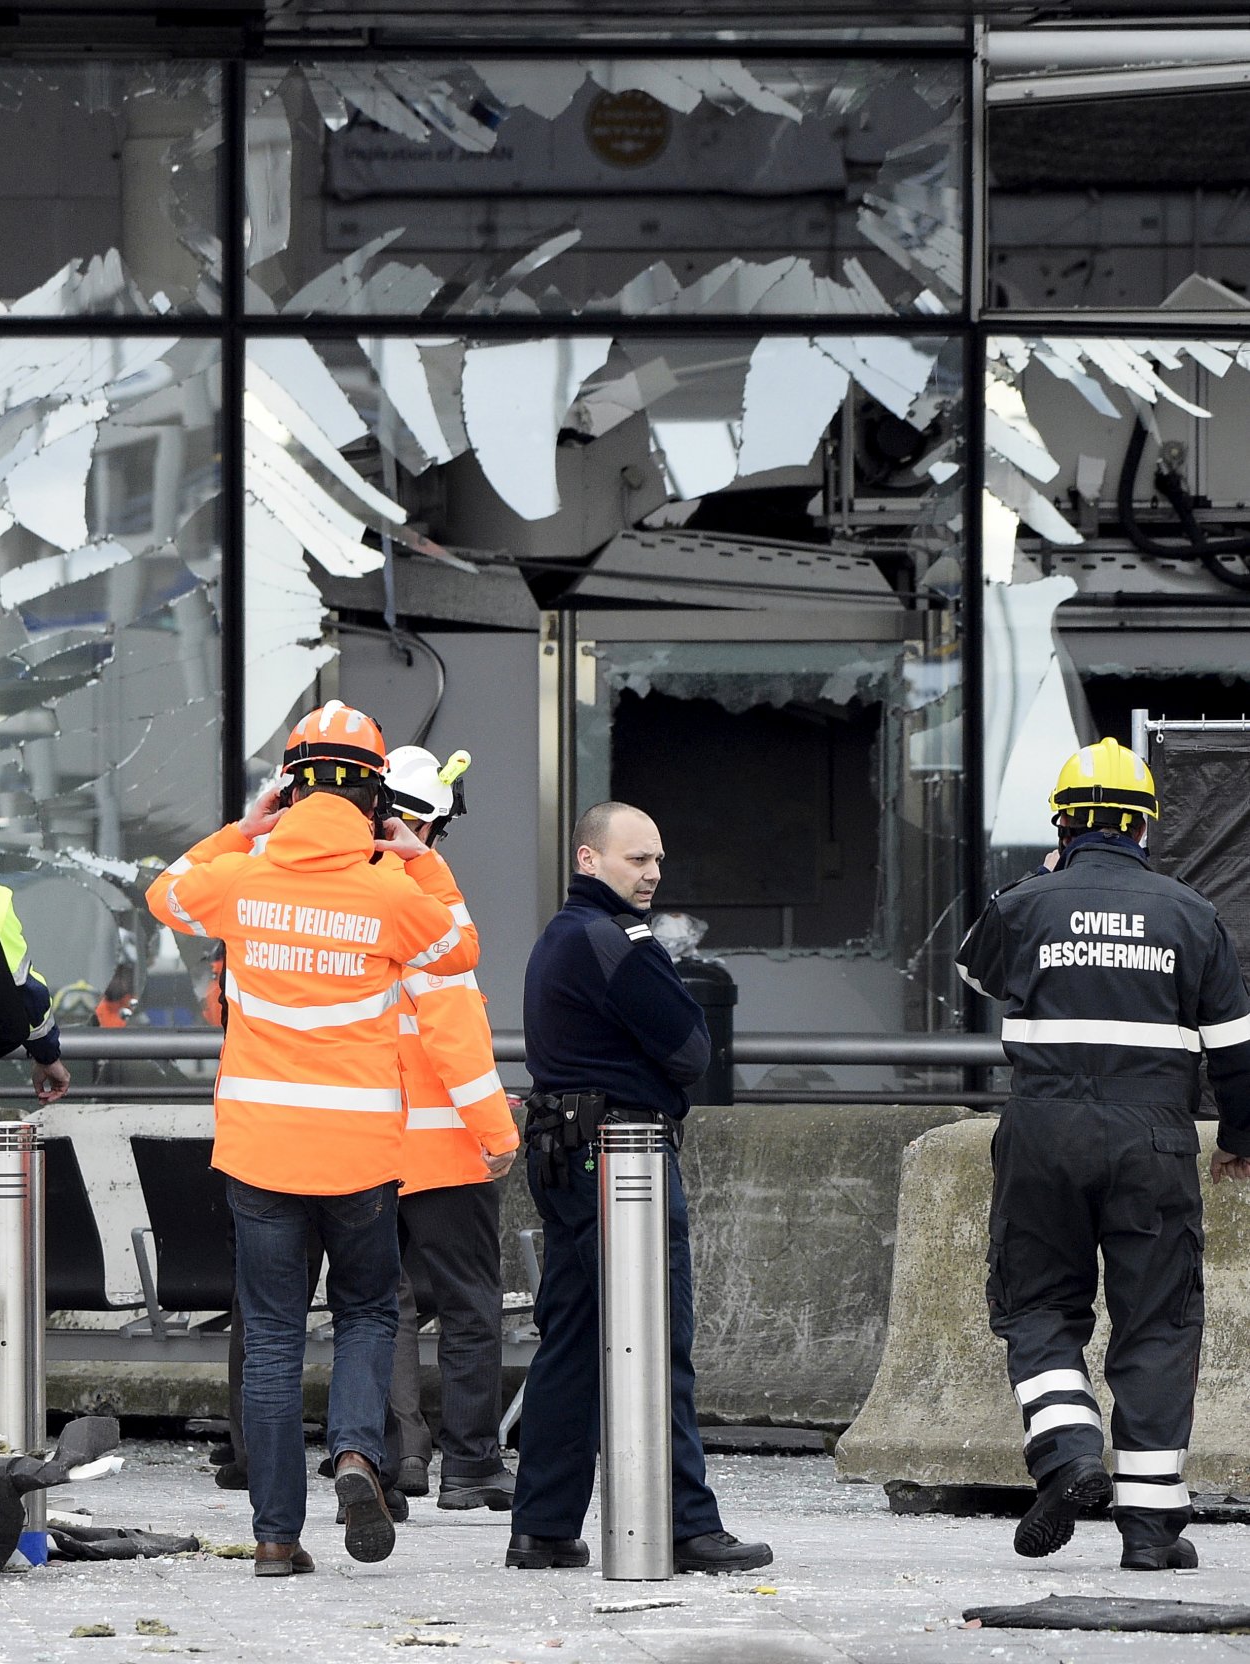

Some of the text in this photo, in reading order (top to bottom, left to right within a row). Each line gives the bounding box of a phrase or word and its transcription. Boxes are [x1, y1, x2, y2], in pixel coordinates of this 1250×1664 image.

[237, 898, 381, 944] CIVIELE VEILIGHEID
[1070, 911, 1145, 938] CIVIELE
[244, 939, 367, 977] SECURITE CIVILE
[1039, 941, 1176, 974] BESCHERMING
